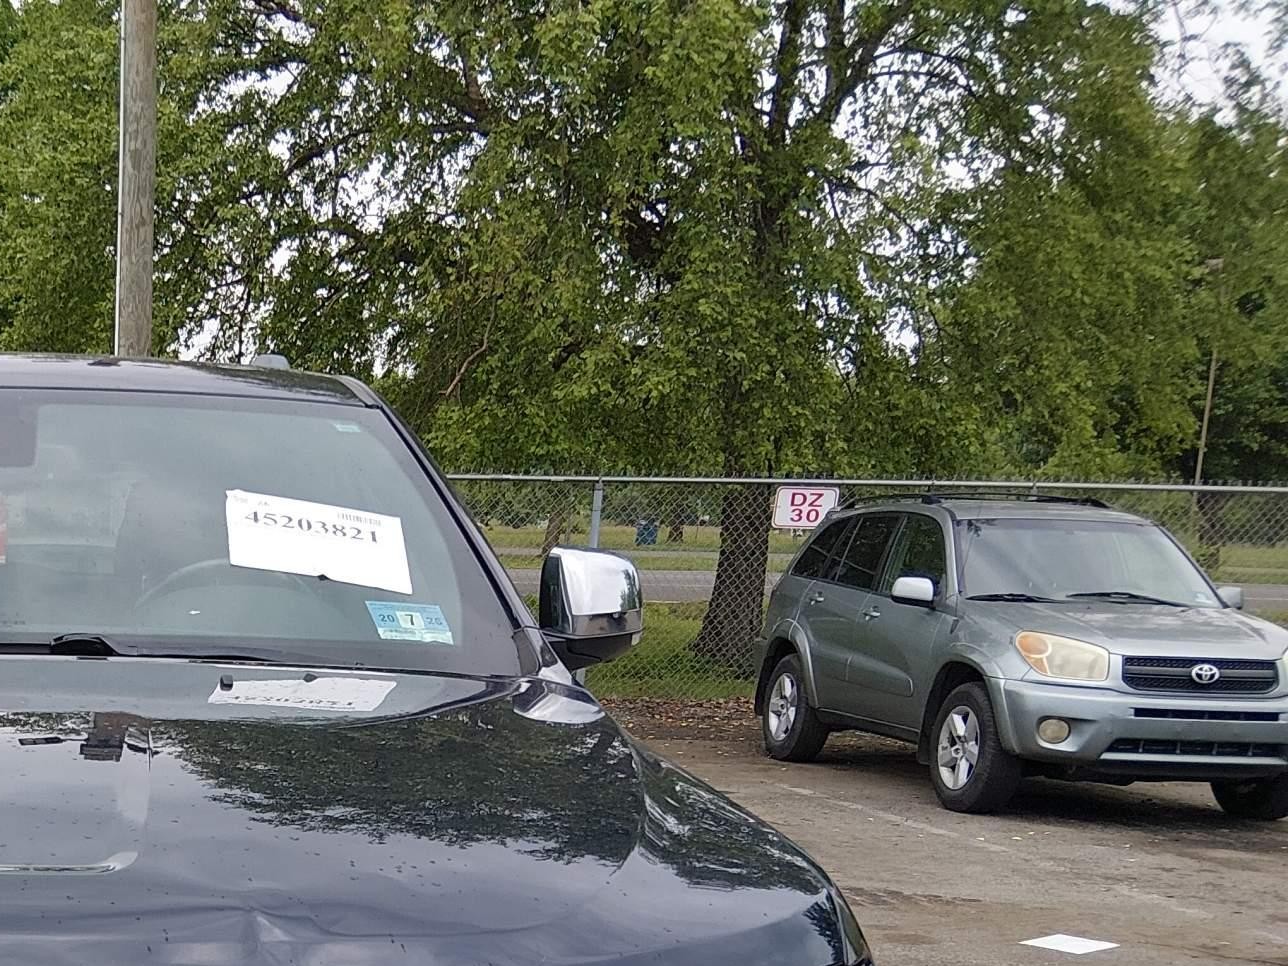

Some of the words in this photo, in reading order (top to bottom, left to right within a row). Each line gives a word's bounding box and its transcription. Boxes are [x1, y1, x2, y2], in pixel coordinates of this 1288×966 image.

[790, 492, 825, 508] DZ
[789, 508, 820, 523] 30
[245, 510, 379, 543] 45203821
[378, 614, 396, 624] 20
[404, 613, 415, 626] 7
